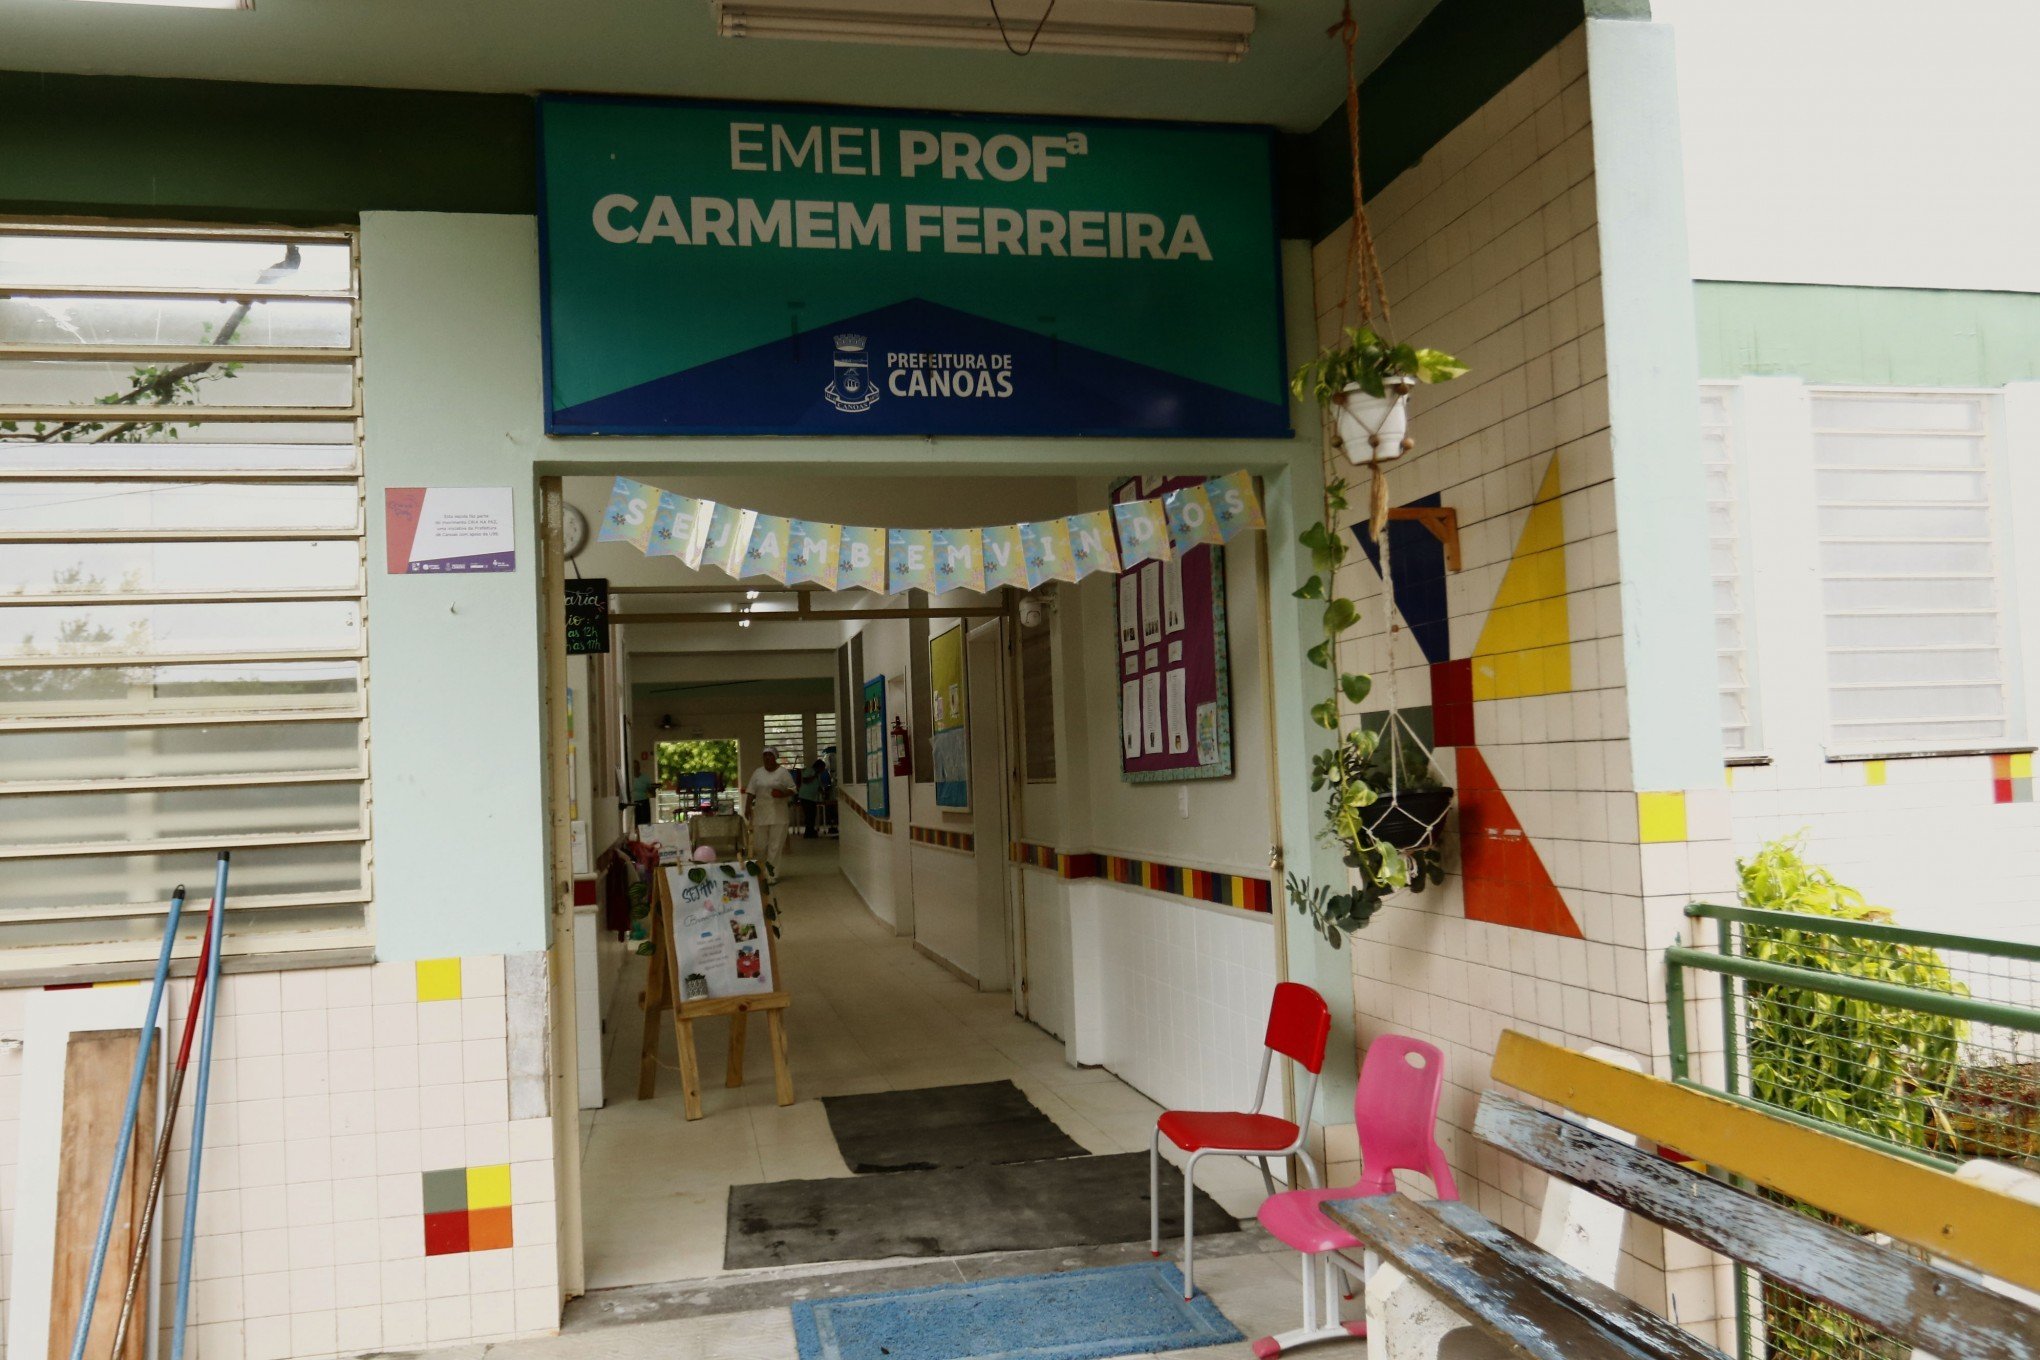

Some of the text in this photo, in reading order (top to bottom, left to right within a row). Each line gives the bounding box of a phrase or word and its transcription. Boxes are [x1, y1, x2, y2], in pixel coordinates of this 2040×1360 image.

[728, 121, 881, 177] EMEI
[591, 193, 1213, 261] CARMEM FERREIRA
[887, 352, 1012, 369] PREFEITURA DE
[888, 370, 1014, 398] CANOAS
